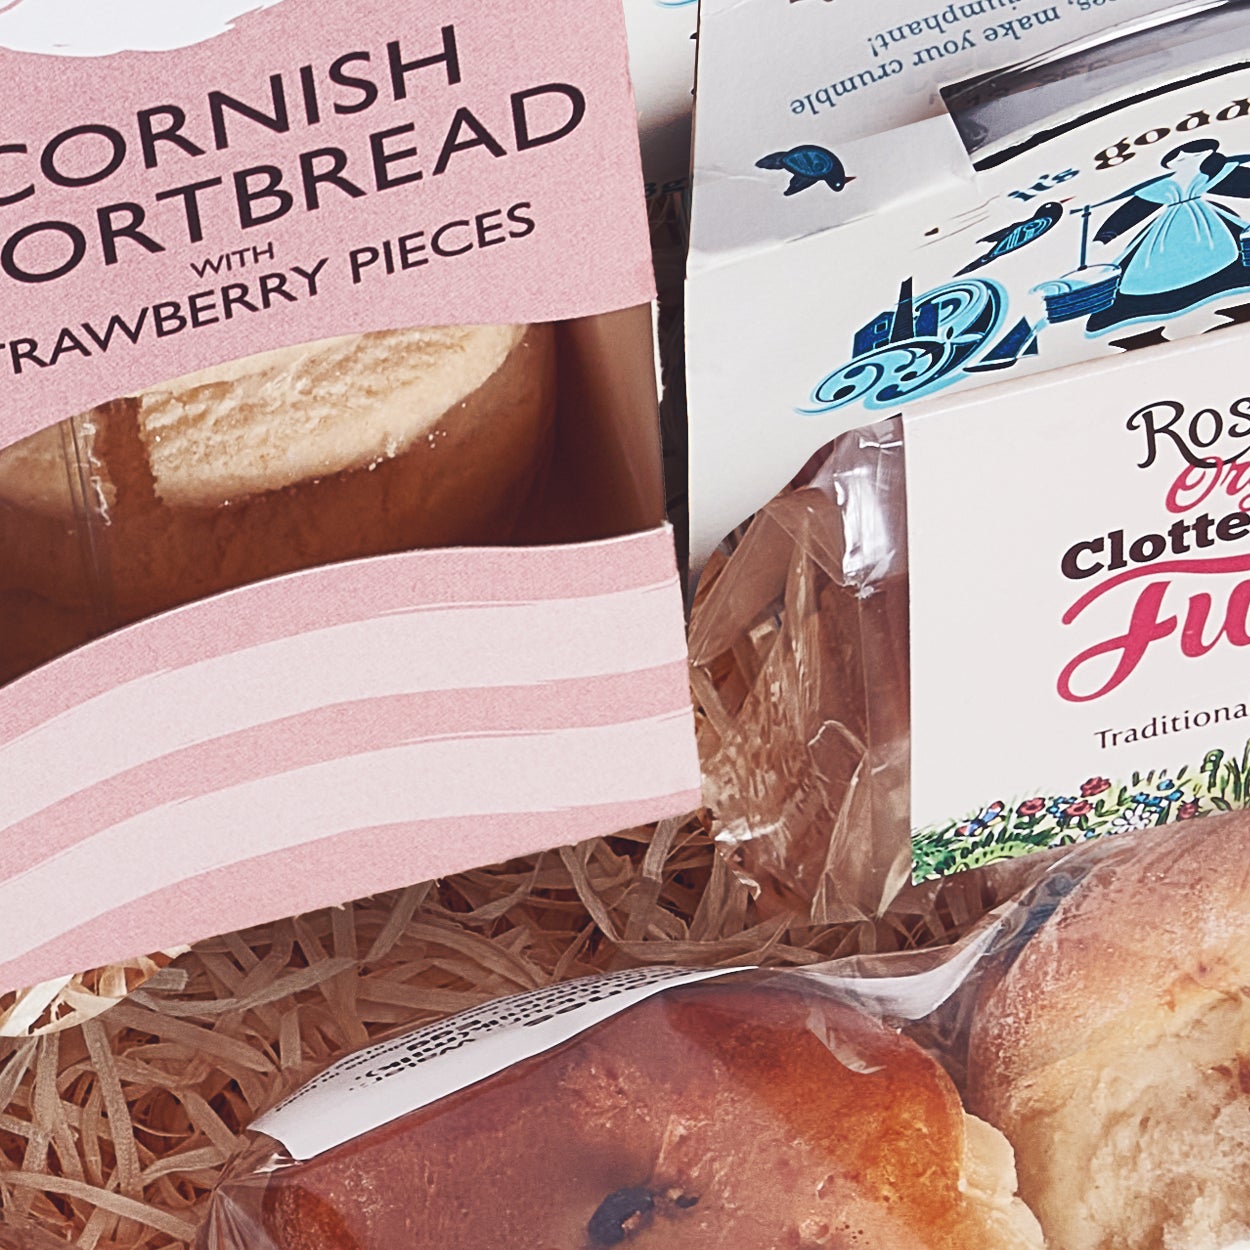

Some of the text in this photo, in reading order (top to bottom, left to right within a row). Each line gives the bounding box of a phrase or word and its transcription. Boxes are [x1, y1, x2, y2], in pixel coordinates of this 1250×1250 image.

[983, 6, 1060, 40] make
[912, 30, 976, 67] your
[790, 58, 903, 116] crumble
[190, 241, 274, 278] WITH
[0, 202, 535, 374] RAWBERRY PIECES
